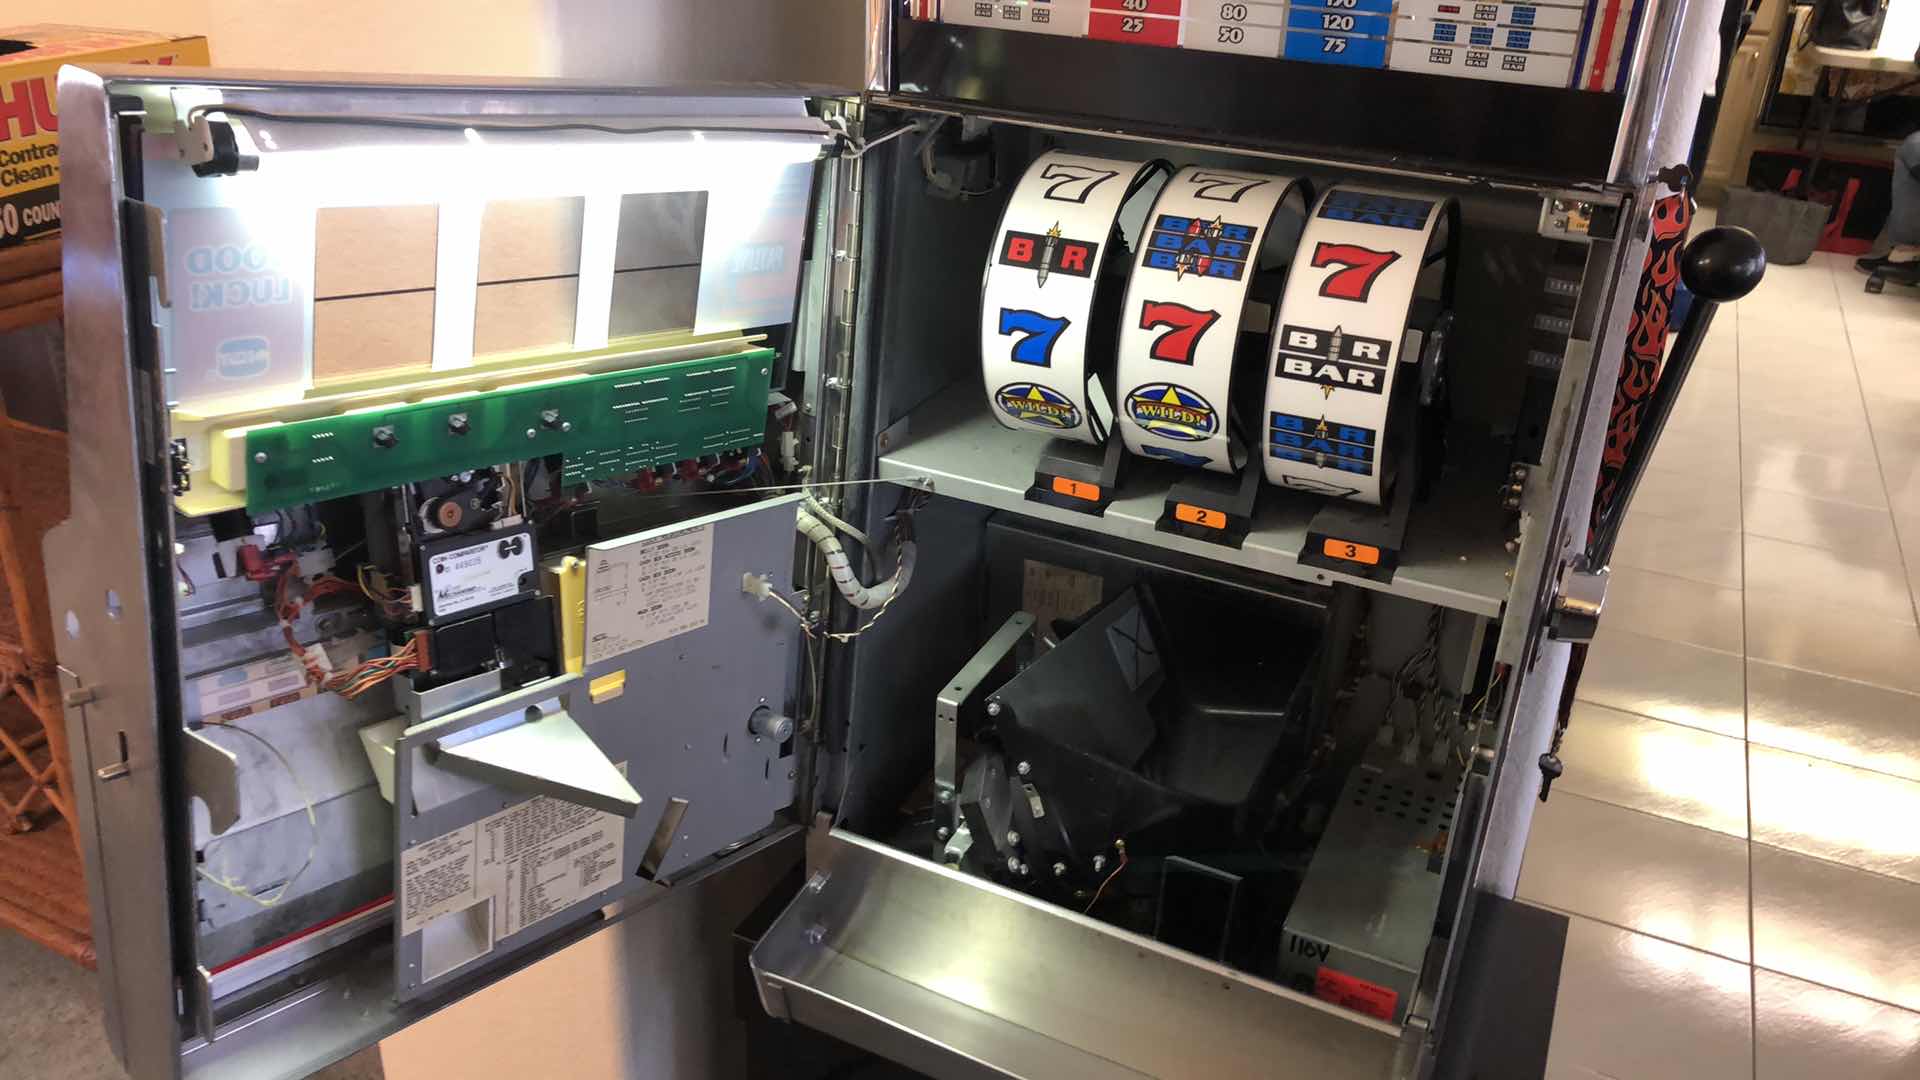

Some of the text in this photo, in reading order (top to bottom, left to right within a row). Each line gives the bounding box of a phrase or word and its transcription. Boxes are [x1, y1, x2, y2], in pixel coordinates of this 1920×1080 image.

[1121, 16, 1144, 33] 25
[1221, 4, 1247, 22] 80
[1321, 14, 1355, 31] 120
[1218, 26, 1244, 43] 50
[1322, 36, 1347, 54] 75
[1040, 163, 1120, 204] 7
[1188, 171, 1271, 203] 7
[1008, 236, 1088, 271] BR
[1155, 233, 1243, 258] BAR
[1311, 242, 1402, 303] 7
[998, 307, 1072, 368] 7
[1139, 300, 1222, 366] 7
[1288, 331, 1380, 360] BR
[1283, 358, 1376, 387] BAR
[1141, 404, 1205, 426] WILD!
[1069, 483, 1078, 495] 1
[1196, 510, 1208, 524] 2
[1344, 544, 1357, 559] 3
